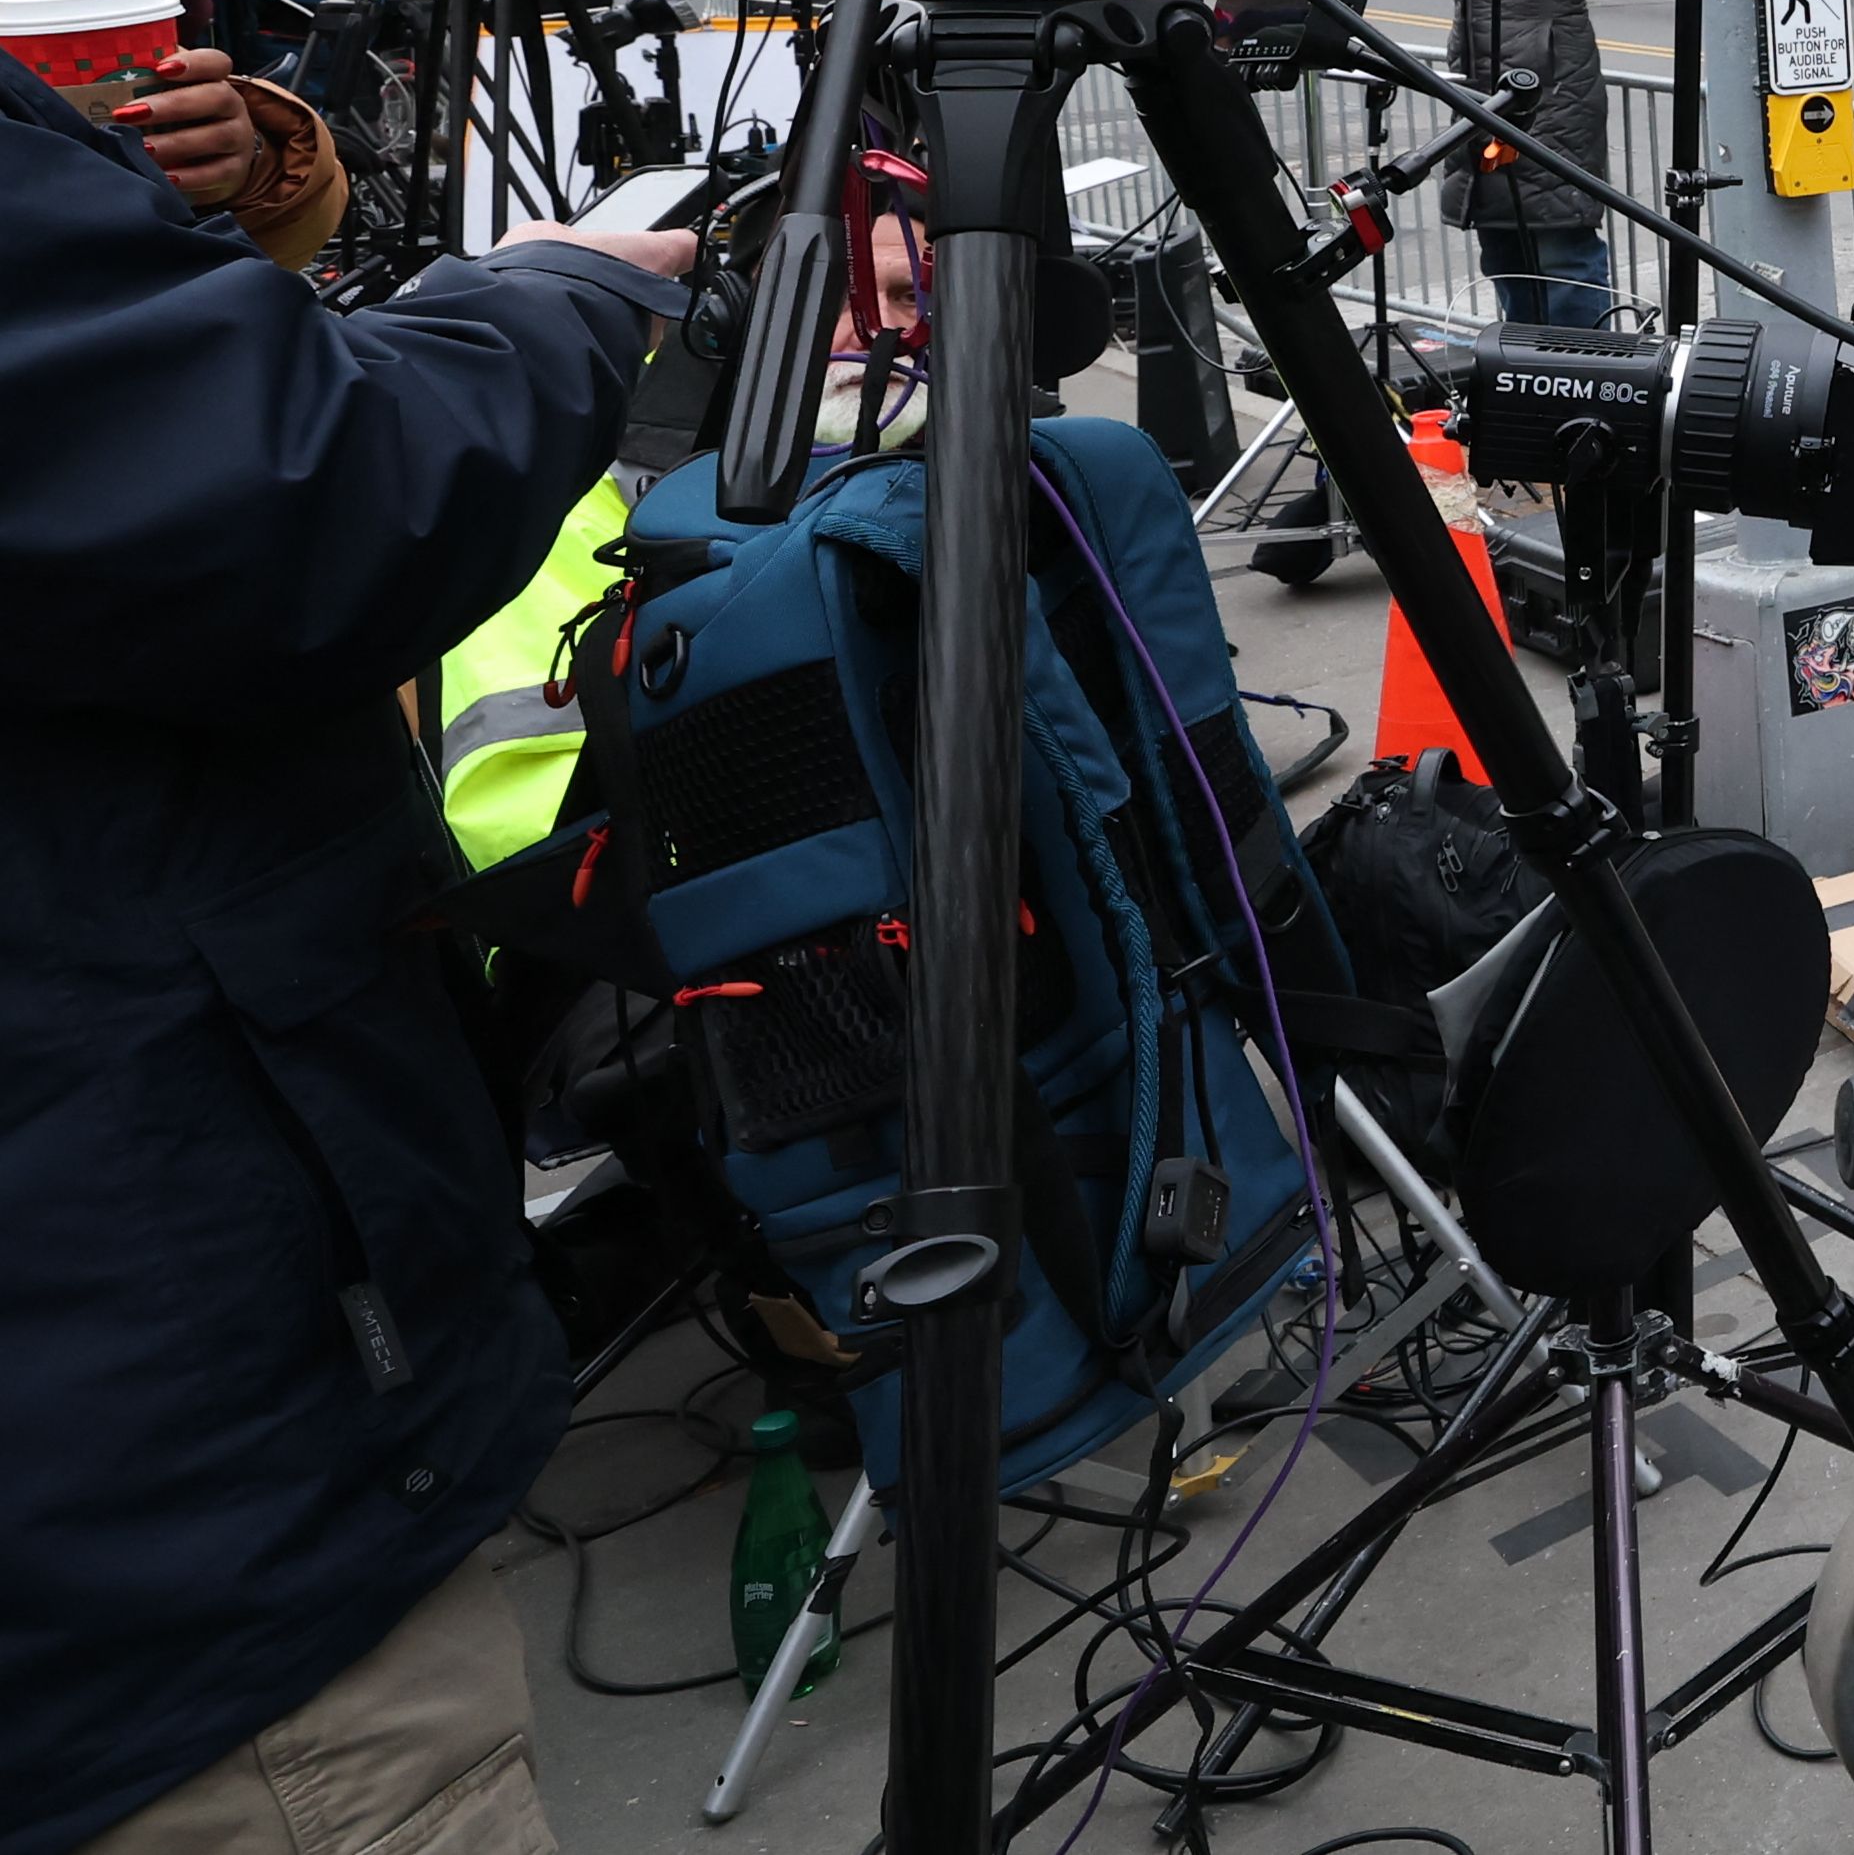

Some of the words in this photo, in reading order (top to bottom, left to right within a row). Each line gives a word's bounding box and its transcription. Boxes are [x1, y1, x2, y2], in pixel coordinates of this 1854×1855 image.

[1796, 27, 1826, 39] PUSH
[1778, 40, 1821, 54] BUTTON
[1823, 38, 1845, 51] FOR
[1789, 52, 1837, 67] AUDIBLE
[1793, 66, 1834, 81] SIGNAL
[1496, 372, 1594, 400] STORM
